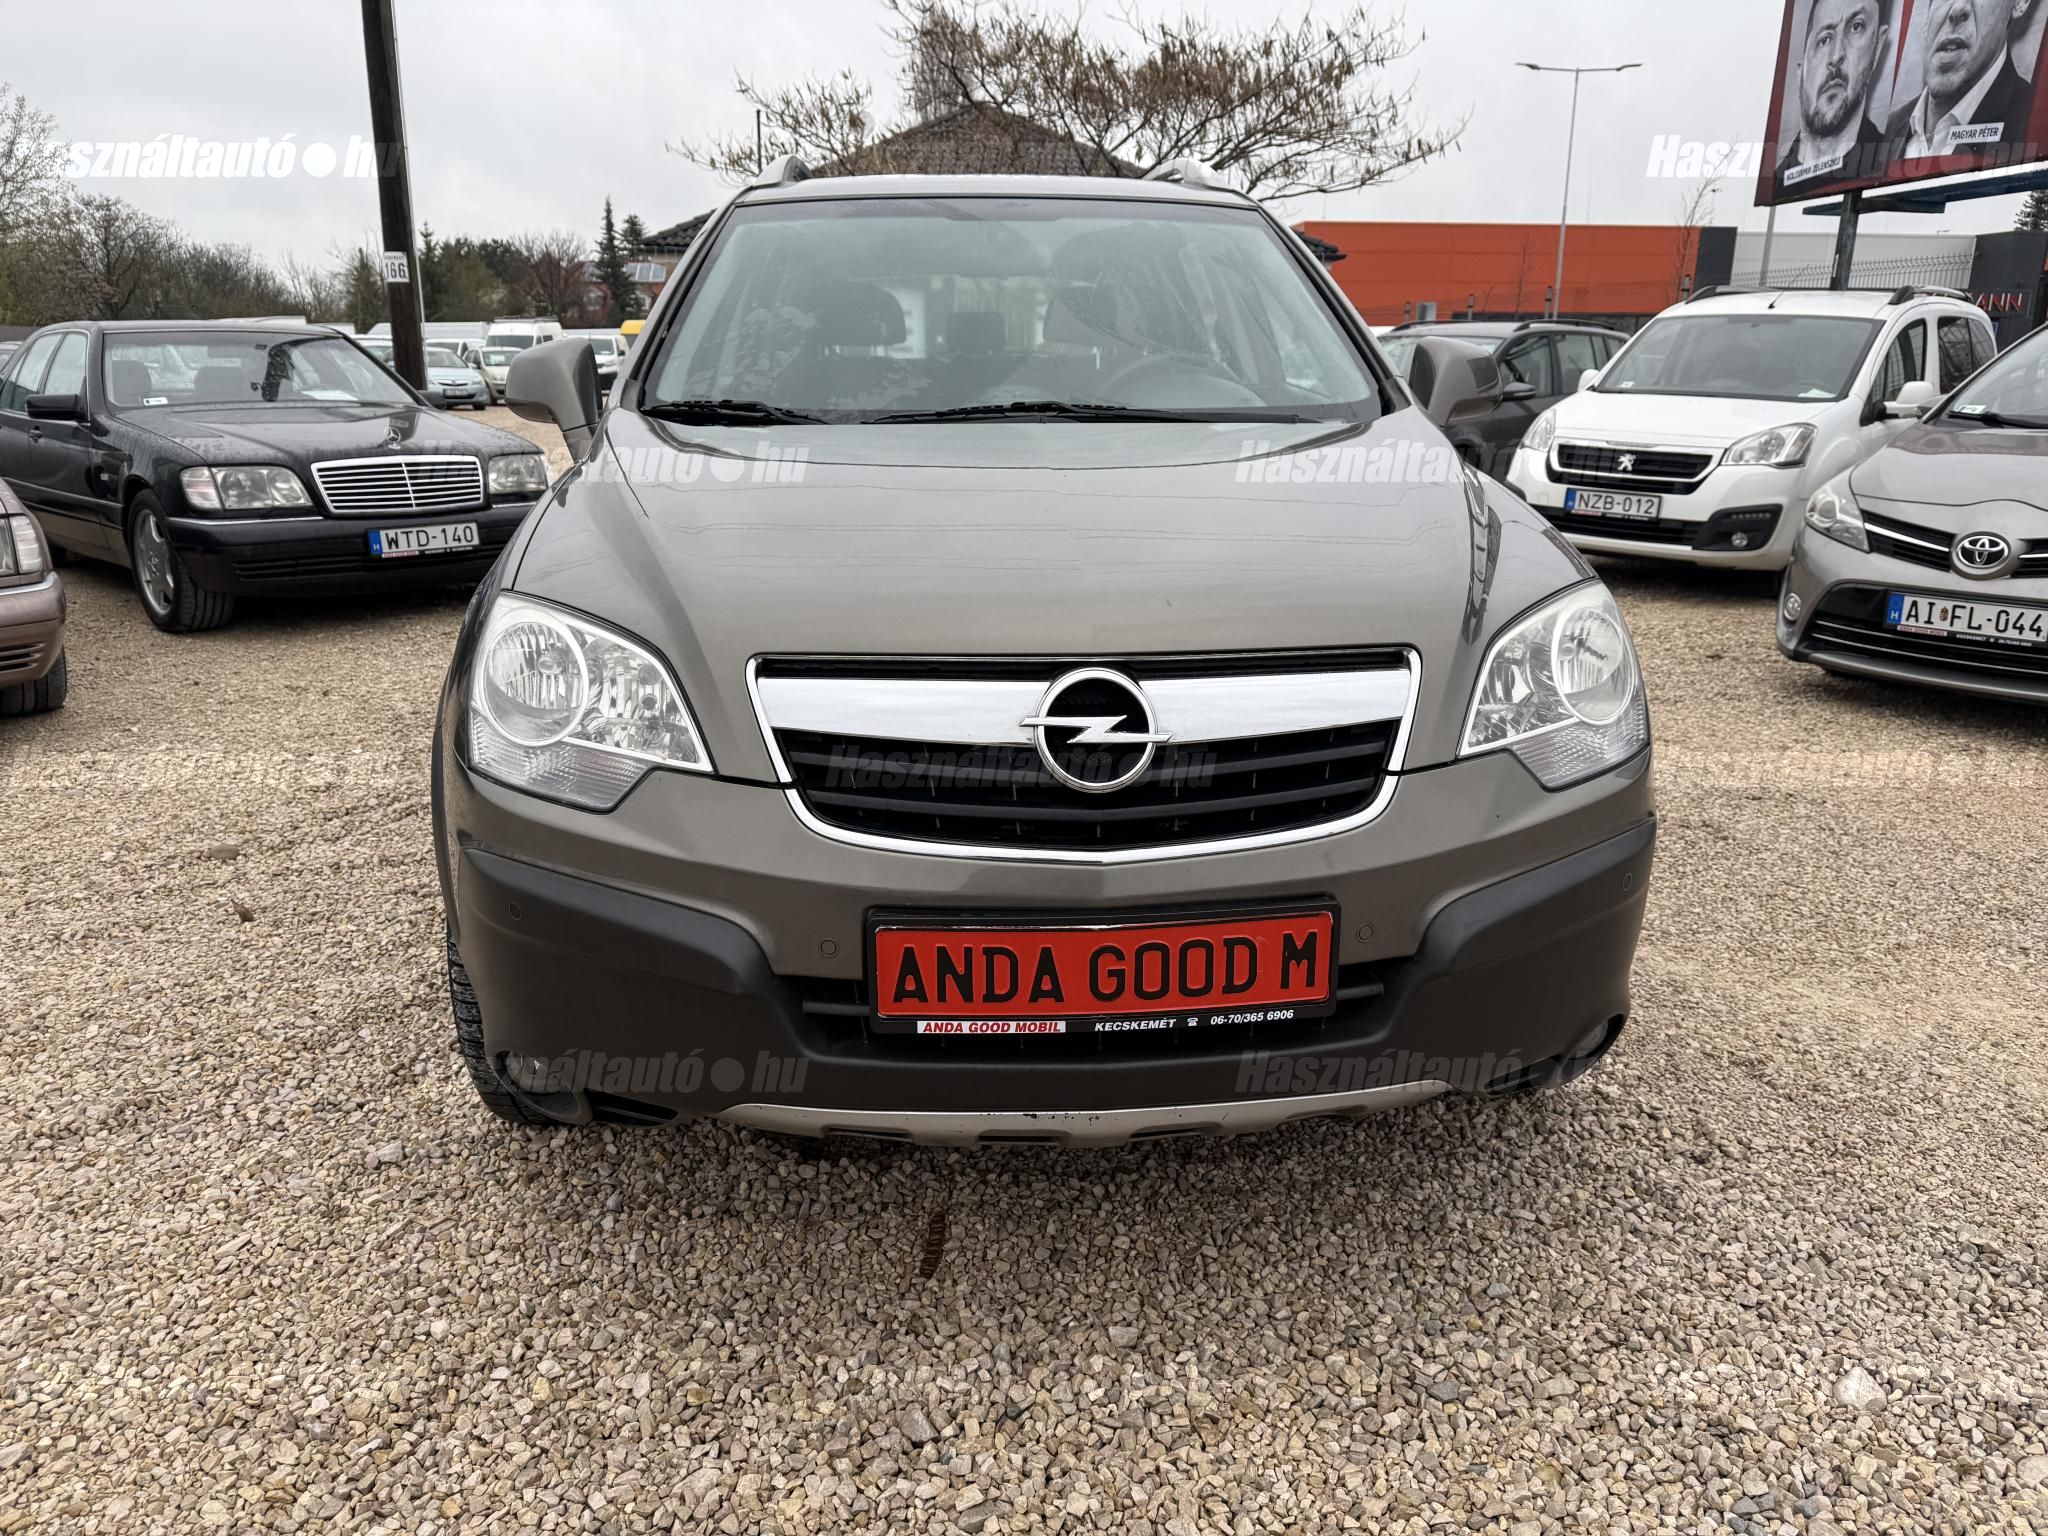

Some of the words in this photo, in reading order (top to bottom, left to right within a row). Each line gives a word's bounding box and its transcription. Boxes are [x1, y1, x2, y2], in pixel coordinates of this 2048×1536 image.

[1950, 129, 1978, 141] MAGYAR
[1978, 125, 1999, 138] PÉTER
[384, 262, 406, 279] 166
[1578, 493, 1655, 515] NZB-012
[385, 525, 474, 550] WTD-140
[892, 946, 1065, 1003] ANDA
[1088, 935, 1258, 1003] GOOD
[1280, 930, 1318, 990] M
[923, 1022, 963, 1033] ANDA
[968, 1022, 1011, 1033] GOOD
[1014, 1022, 1062, 1033] MOBIL
[1095, 1017, 1177, 1032] KECSKEMÉT
[1210, 1012, 1264, 1026] 06-70/365
[1267, 1009, 1294, 1021] 6906
